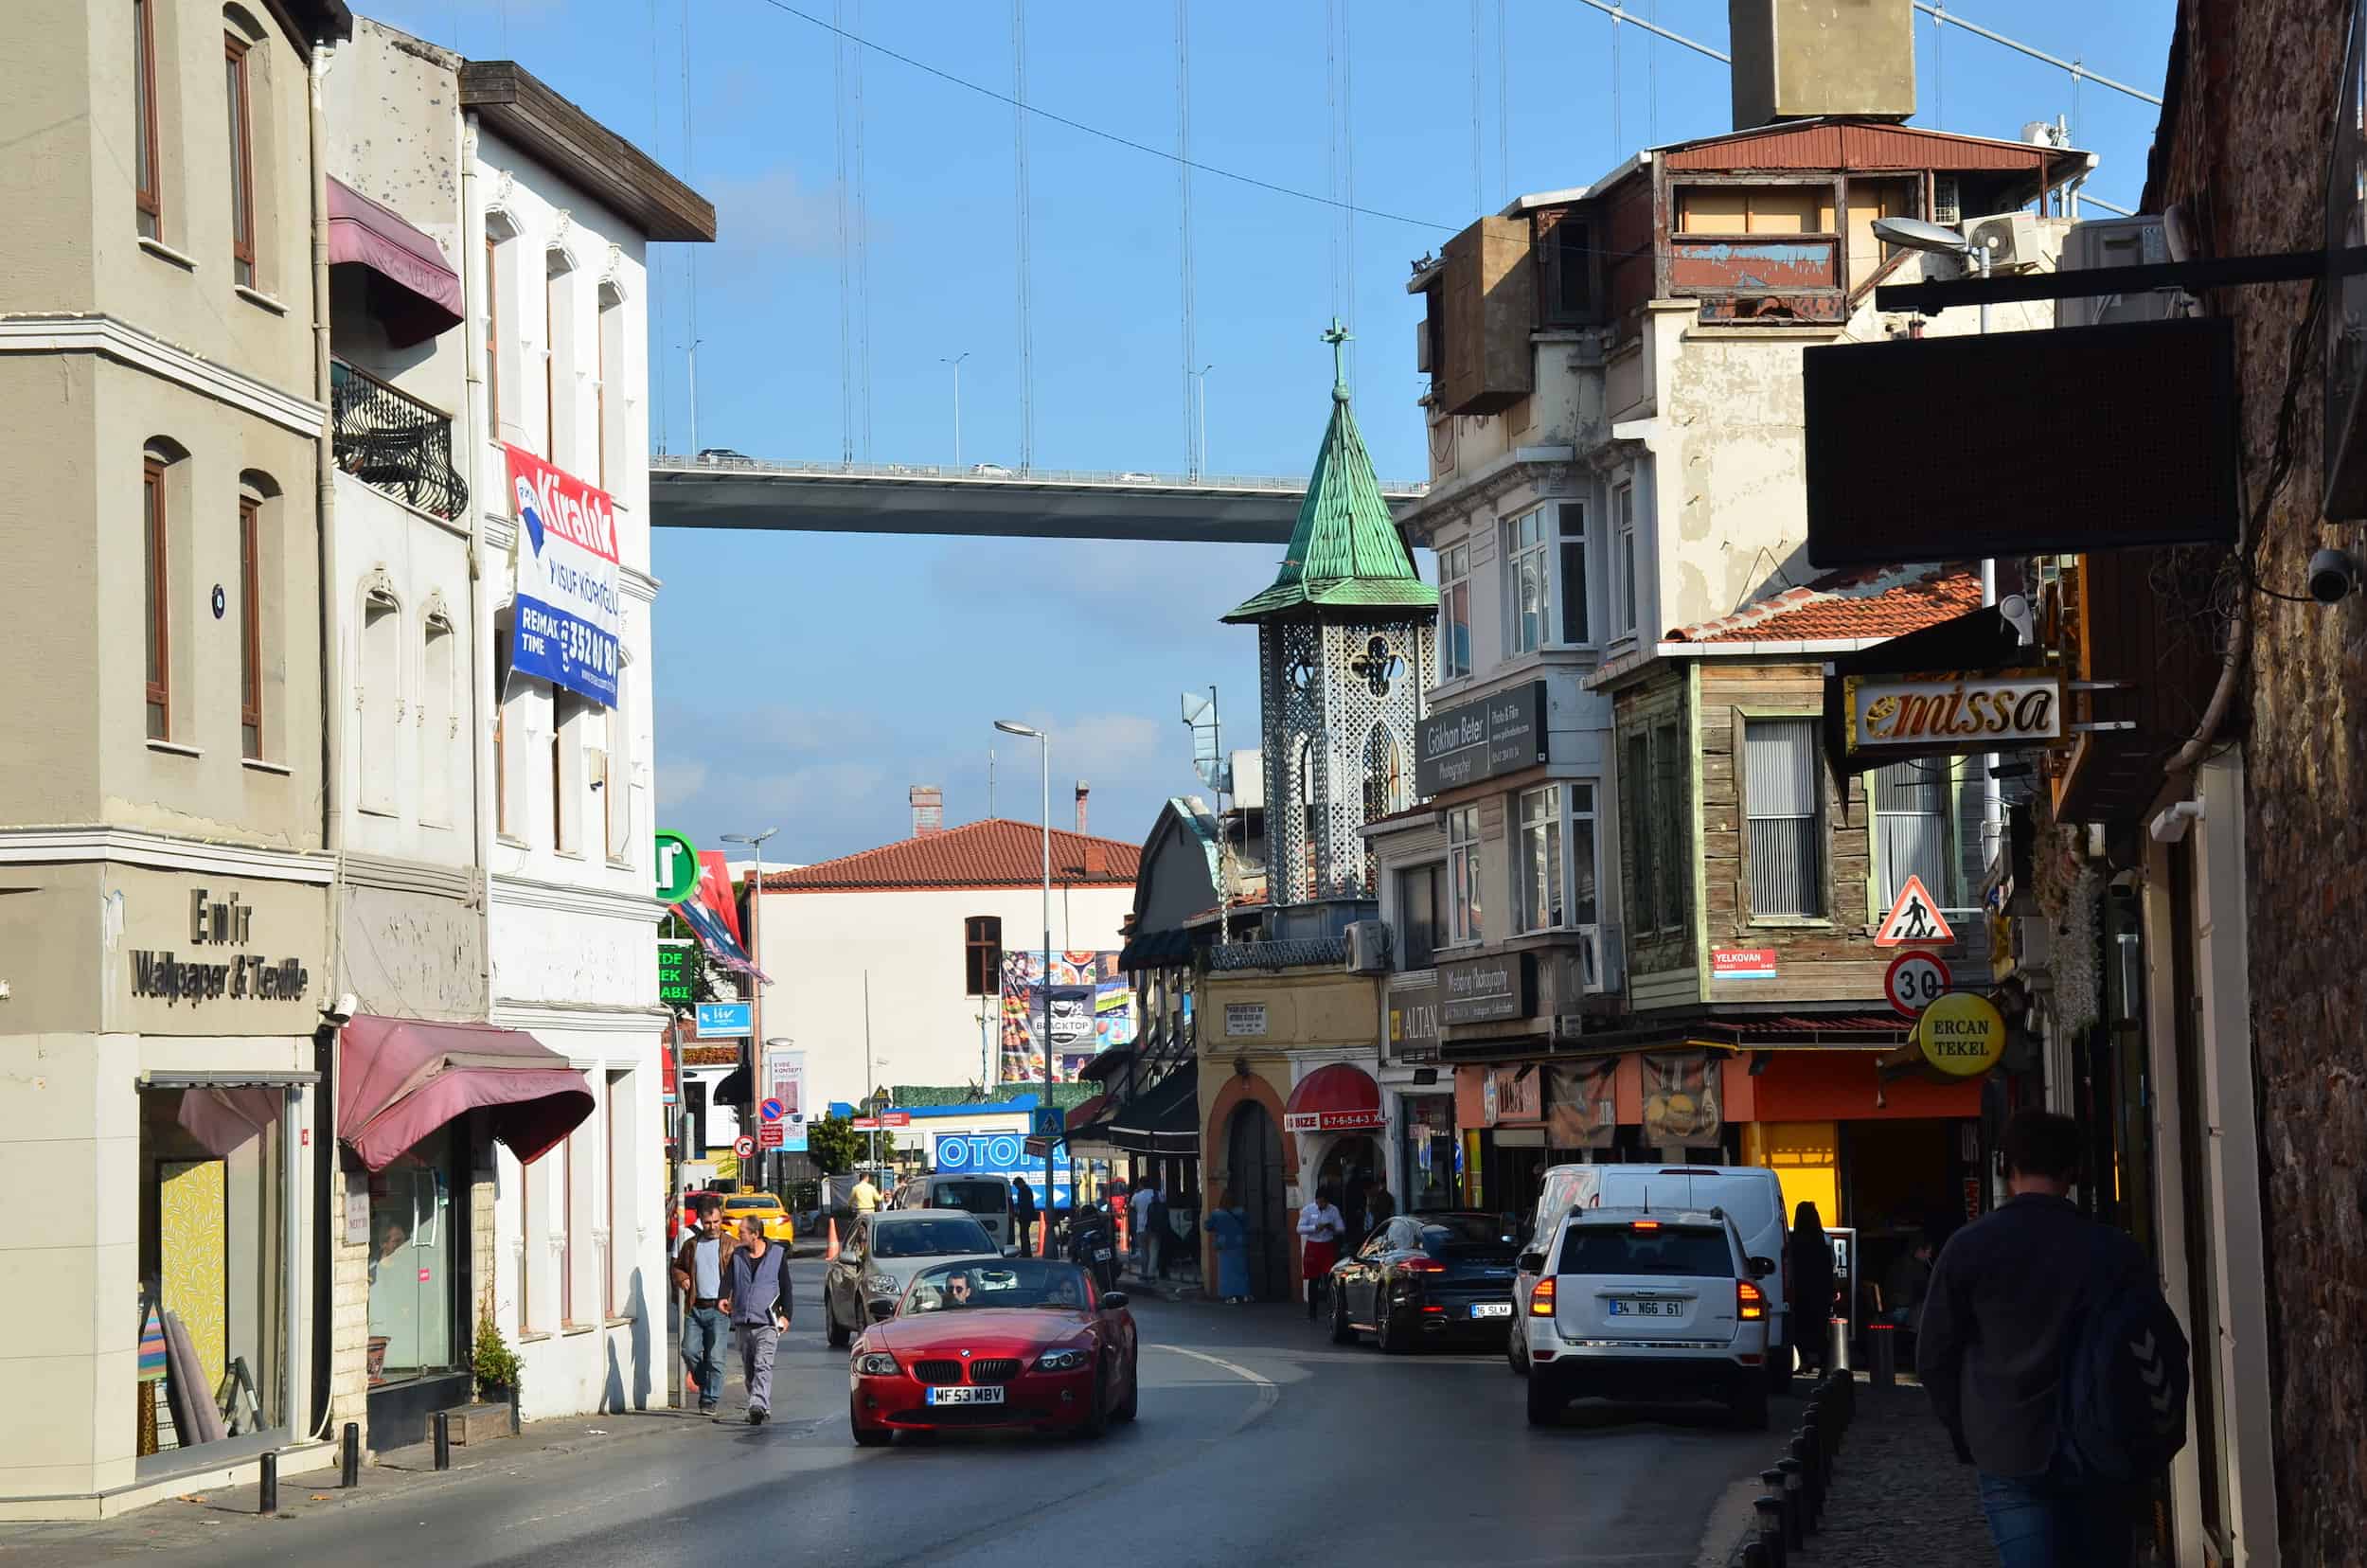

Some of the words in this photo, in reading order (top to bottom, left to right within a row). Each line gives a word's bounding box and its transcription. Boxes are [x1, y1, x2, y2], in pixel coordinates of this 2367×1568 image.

[537, 468, 615, 558] Kiralık
[549, 558, 577, 593] YUSUF
[522, 633, 545, 655] TIME
[1864, 684, 2053, 739] emissa
[1427, 722, 1459, 755] Gökhan
[189, 888, 252, 946] Emir
[1716, 953, 1761, 962] YELKOVAN
[129, 950, 230, 1008] Wallpaper
[227, 953, 247, 1000] &
[246, 955, 309, 1002] Textile
[1899, 970, 1938, 1000] 30
[713, 1007, 735, 1019] liv
[1036, 1022, 1089, 1030] BACKTOP
[1933, 1021, 1989, 1034] ERCAN
[1933, 1042, 1990, 1056] TEKEL
[1476, 1306, 1486, 1315] 16
[1488, 1306, 1507, 1315] SLM
[1617, 1302, 1629, 1313] 34
[1666, 1302, 1679, 1314] 61
[974, 1388, 1001, 1401] MBV
